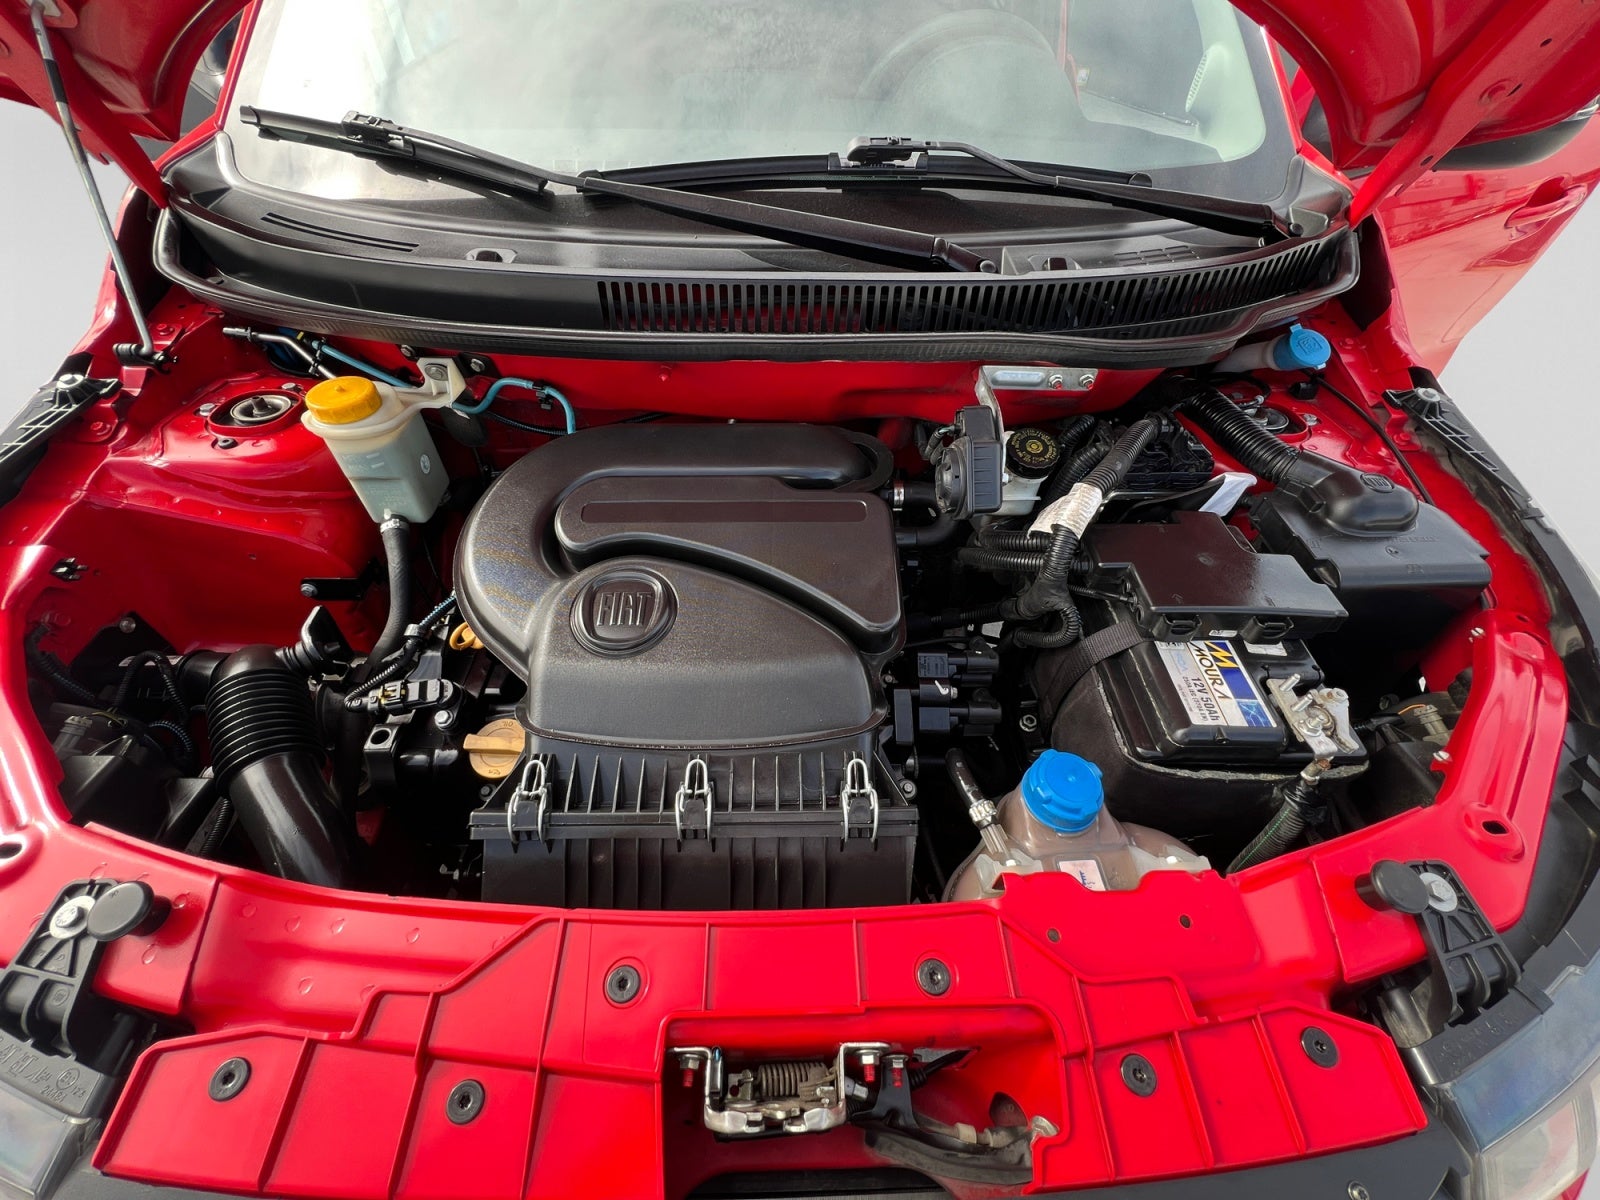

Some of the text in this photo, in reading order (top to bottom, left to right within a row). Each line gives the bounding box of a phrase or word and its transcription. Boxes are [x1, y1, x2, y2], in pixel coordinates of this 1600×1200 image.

[596, 592, 653, 626] FIAT
[1189, 641, 1232, 700] MOURA
[1191, 677, 1221, 721] 12V 50Ah
